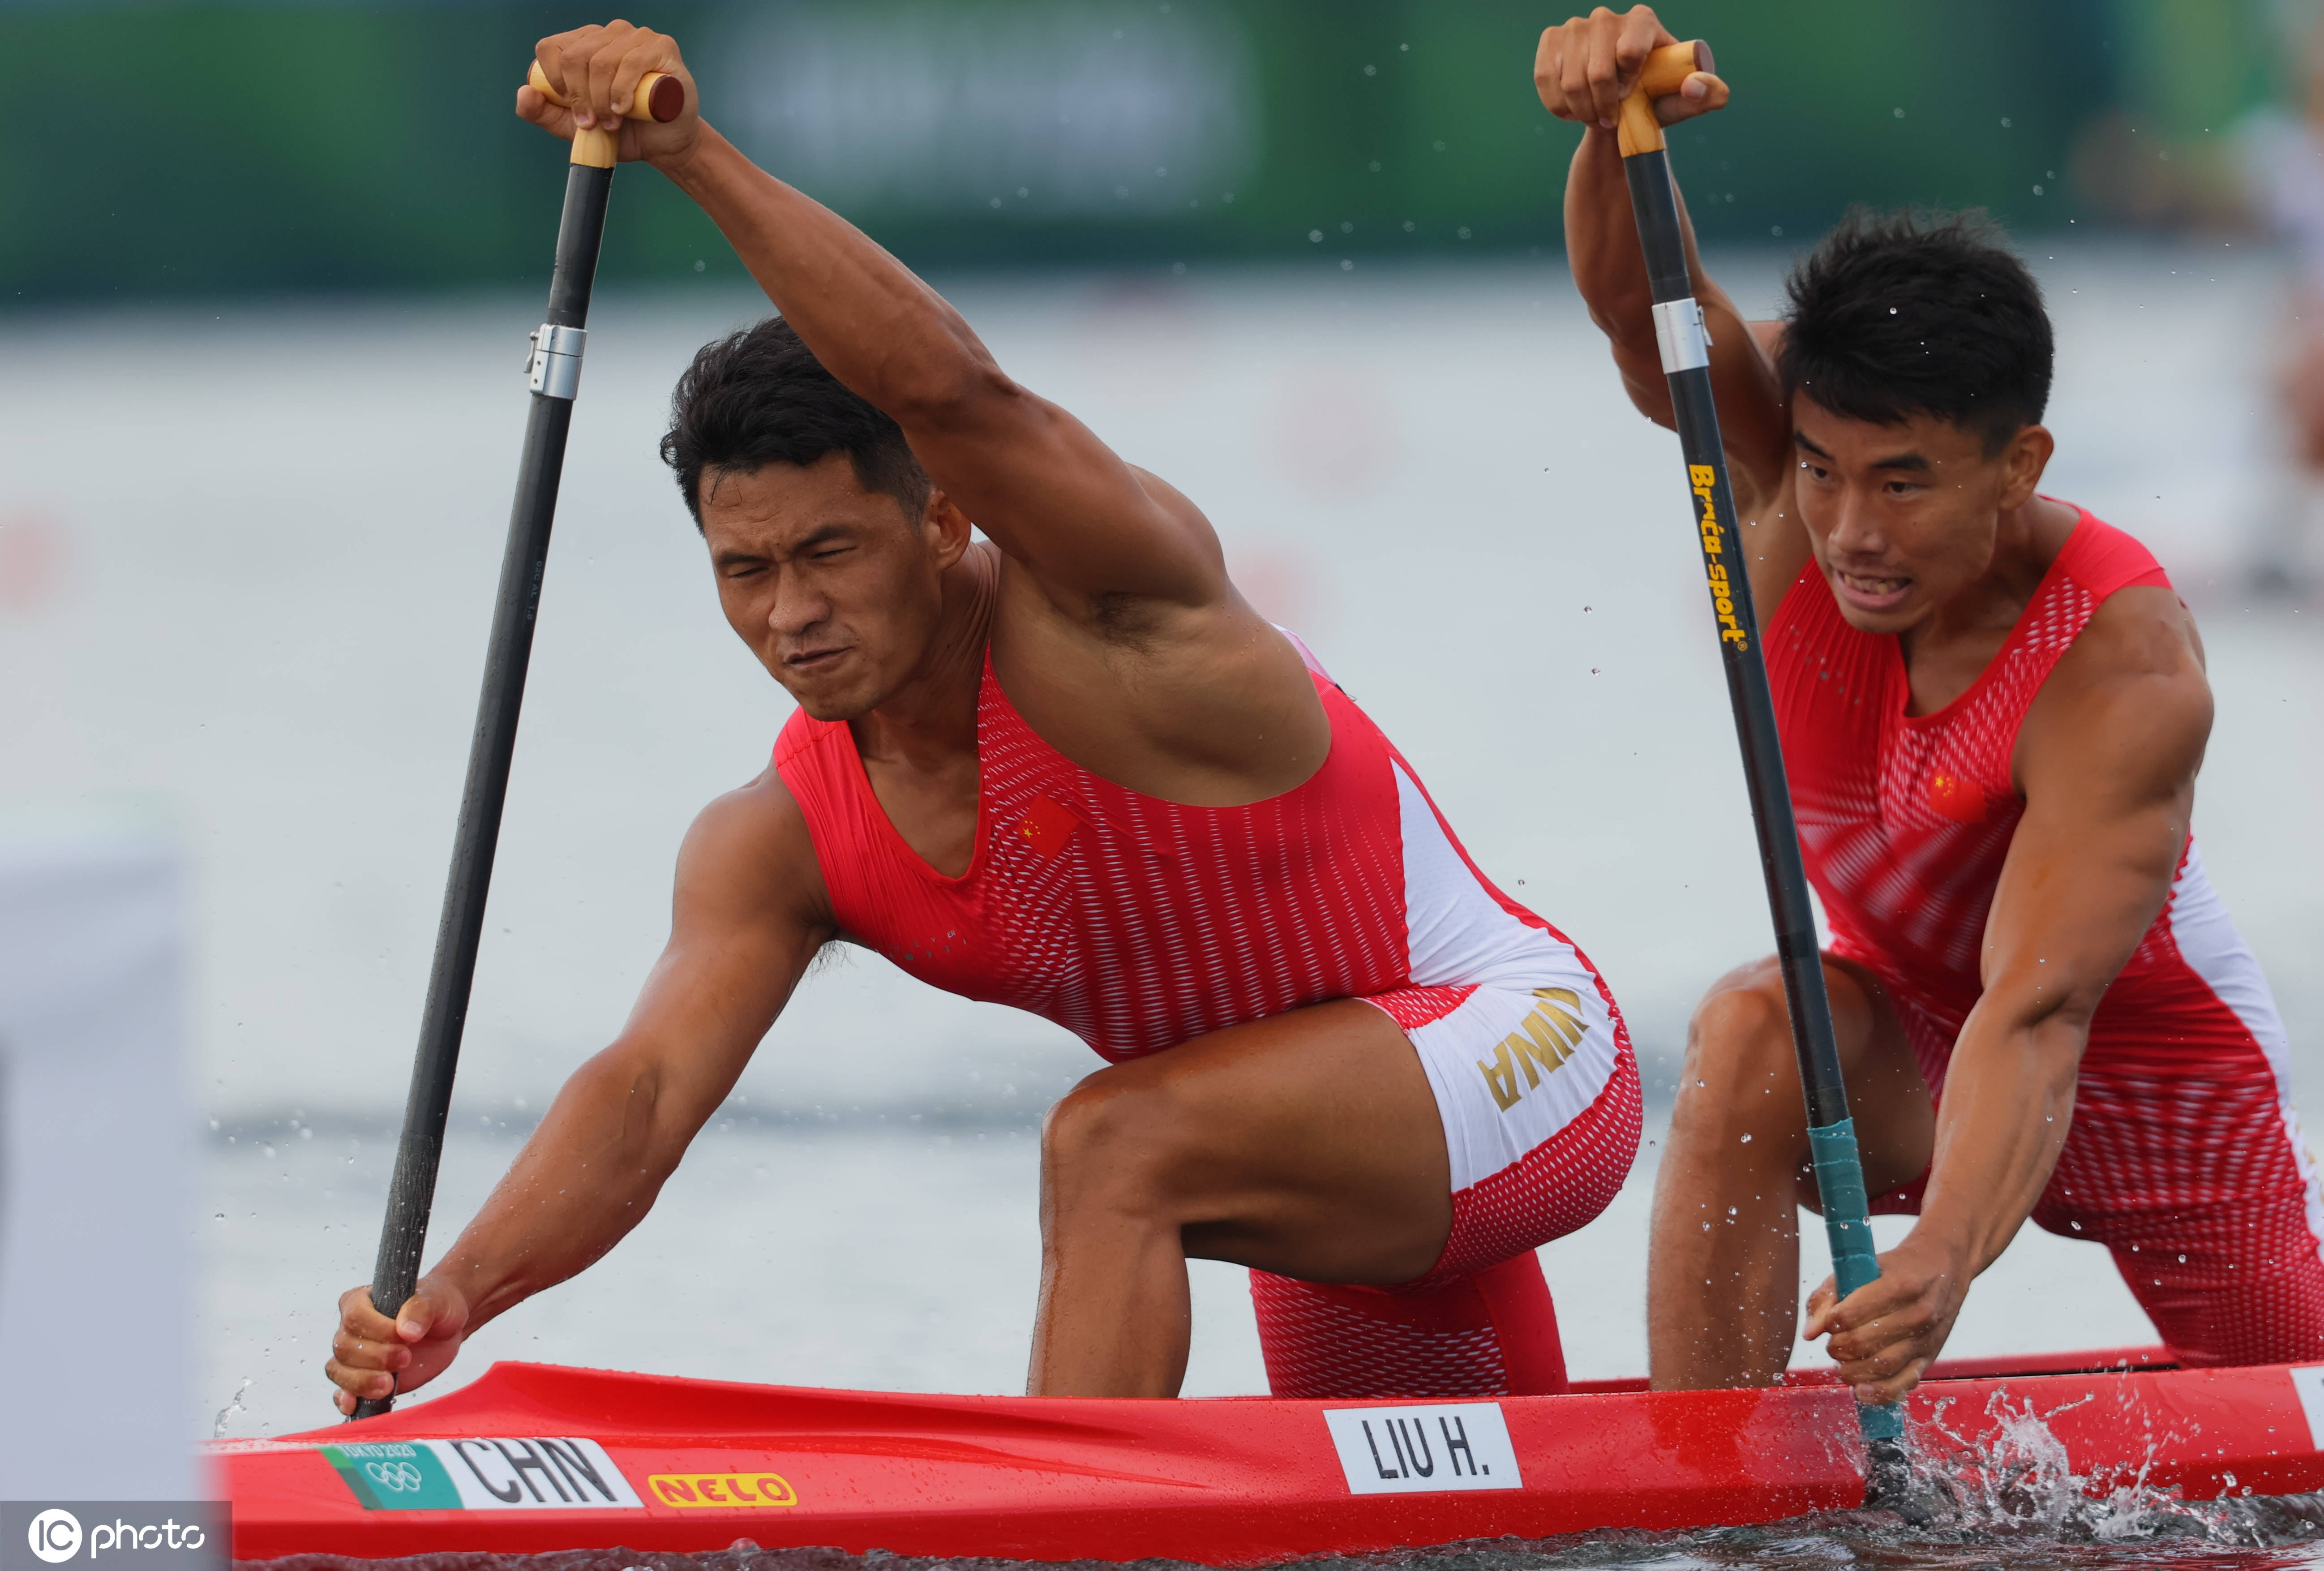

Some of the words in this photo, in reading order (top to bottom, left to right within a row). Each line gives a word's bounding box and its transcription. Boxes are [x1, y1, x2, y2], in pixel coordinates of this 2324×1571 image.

[379, 1444, 417, 1457] 2020
[1362, 1417, 1434, 1478] LIU
[1438, 1416, 1490, 1476] H.
[447, 1437, 618, 1503] CHN
[656, 1477, 790, 1502] NELO
